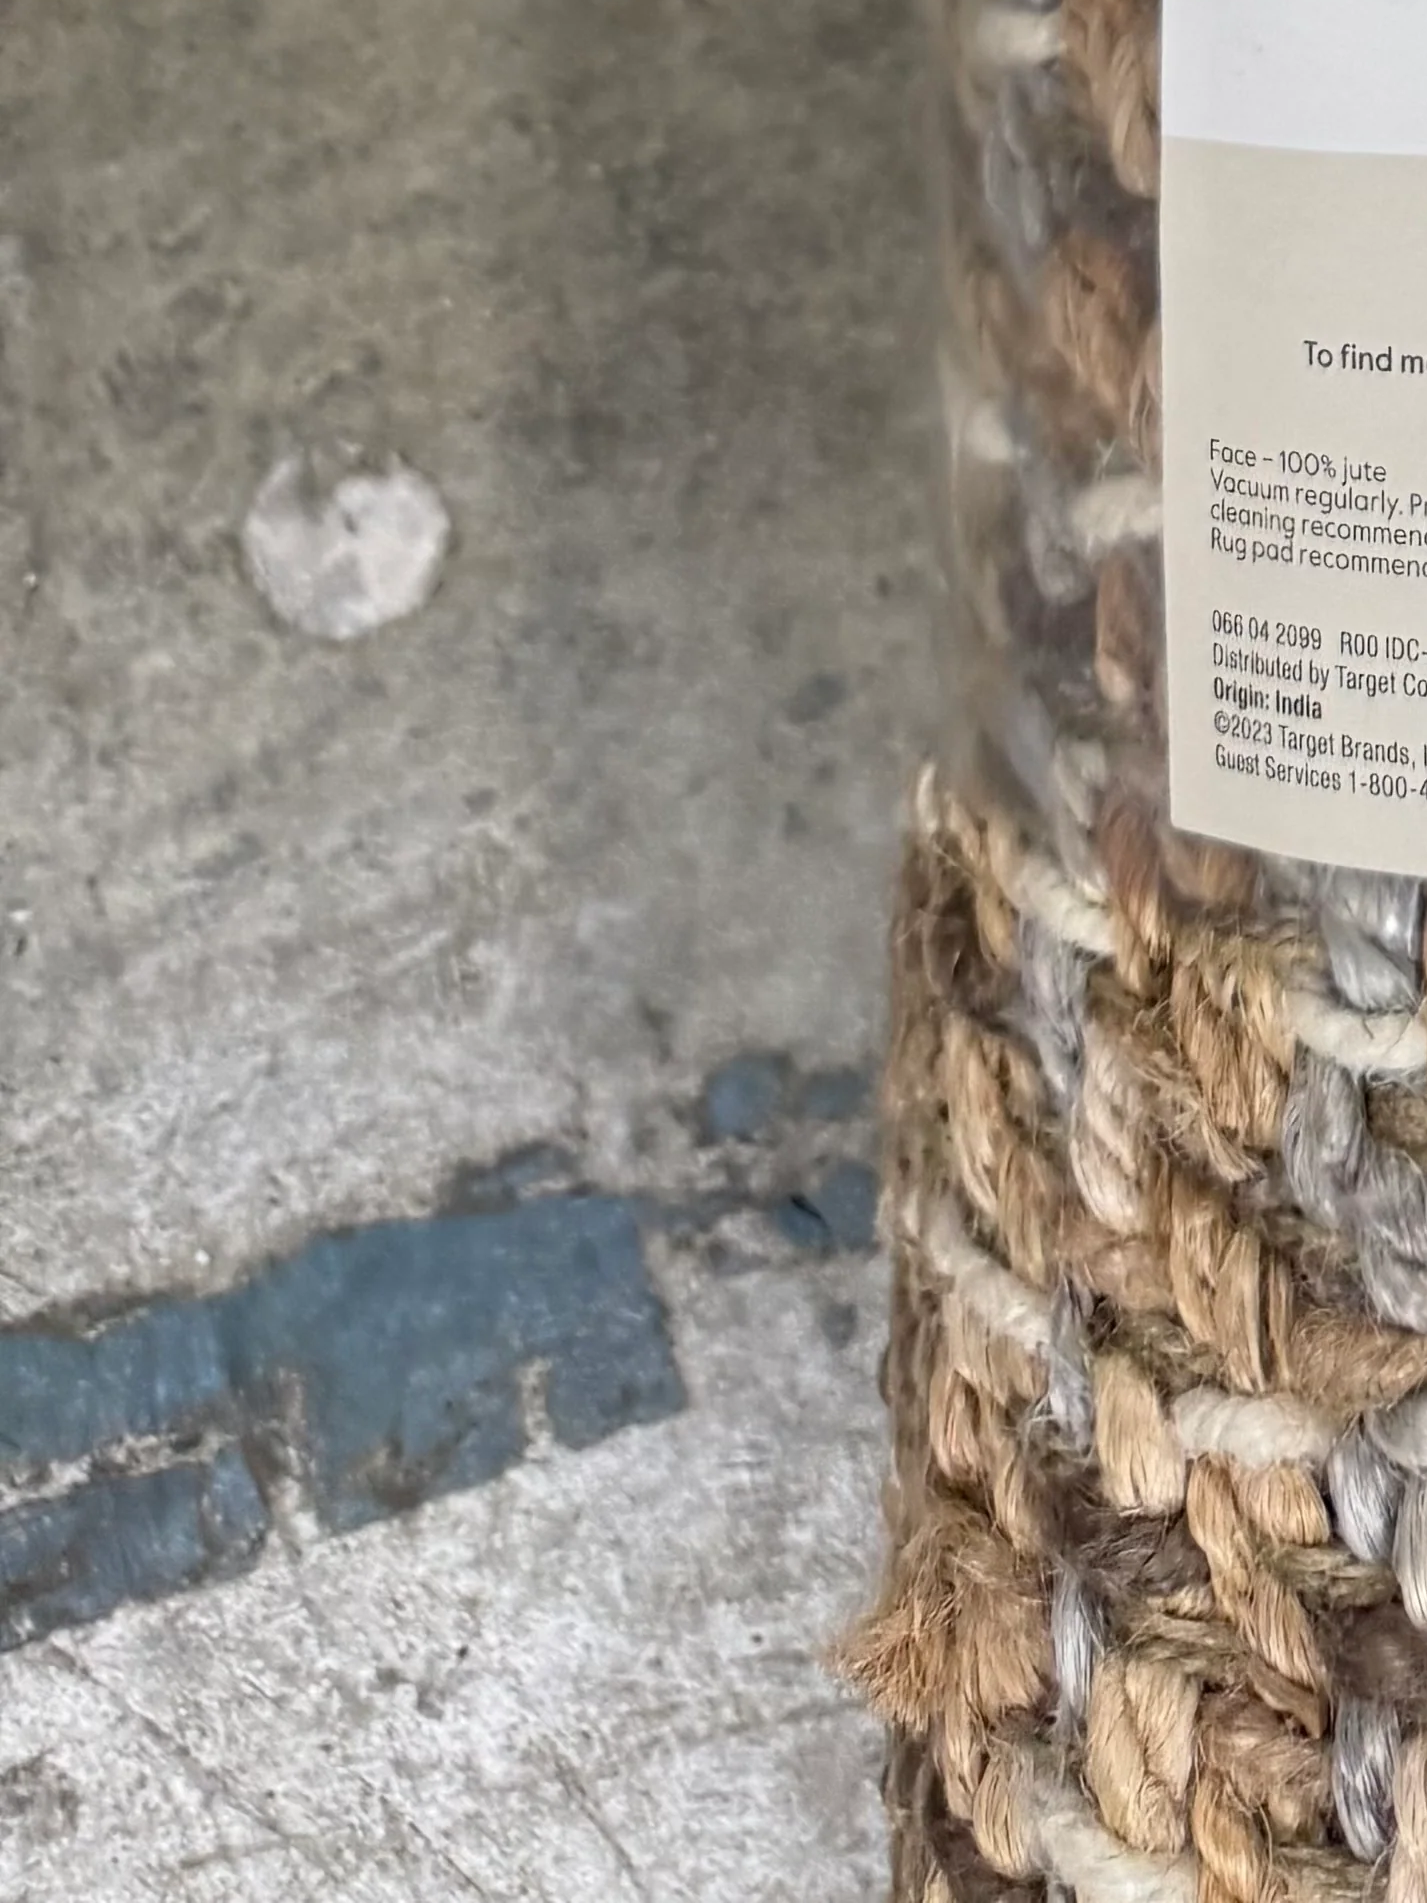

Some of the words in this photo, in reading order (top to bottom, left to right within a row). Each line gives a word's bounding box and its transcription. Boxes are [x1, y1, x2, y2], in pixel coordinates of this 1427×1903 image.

[1303, 339, 1334, 370] To
[1340, 343, 1393, 373] find
[1209, 437, 1257, 468] Face
[1279, 449, 1337, 479] 100%
[1341, 455, 1388, 487] jute
[1209, 466, 1290, 503] Vacuum
[1295, 486, 1404, 521] regularly.
[1209, 497, 1296, 539] cleaning
[1210, 526, 1248, 561] Rug
[1251, 538, 1294, 564] pad
[1212, 609, 1244, 638] 066
[1248, 616, 1270, 642] 04
[1275, 621, 1323, 651] 2099
[1340, 630, 1379, 658] R00
[1212, 641, 1303, 683] Distributed
[1308, 662, 1331, 691] by
[1334, 664, 1397, 699] Target
[1213, 675, 1271, 711] Origin:
[1274, 688, 1323, 720] India
[1213, 709, 1274, 745] ©2023
[1277, 723, 1335, 759] Target
[1340, 733, 1417, 771] Brands,
[1214, 743, 1261, 777] Guest
[1264, 755, 1342, 792] Services
